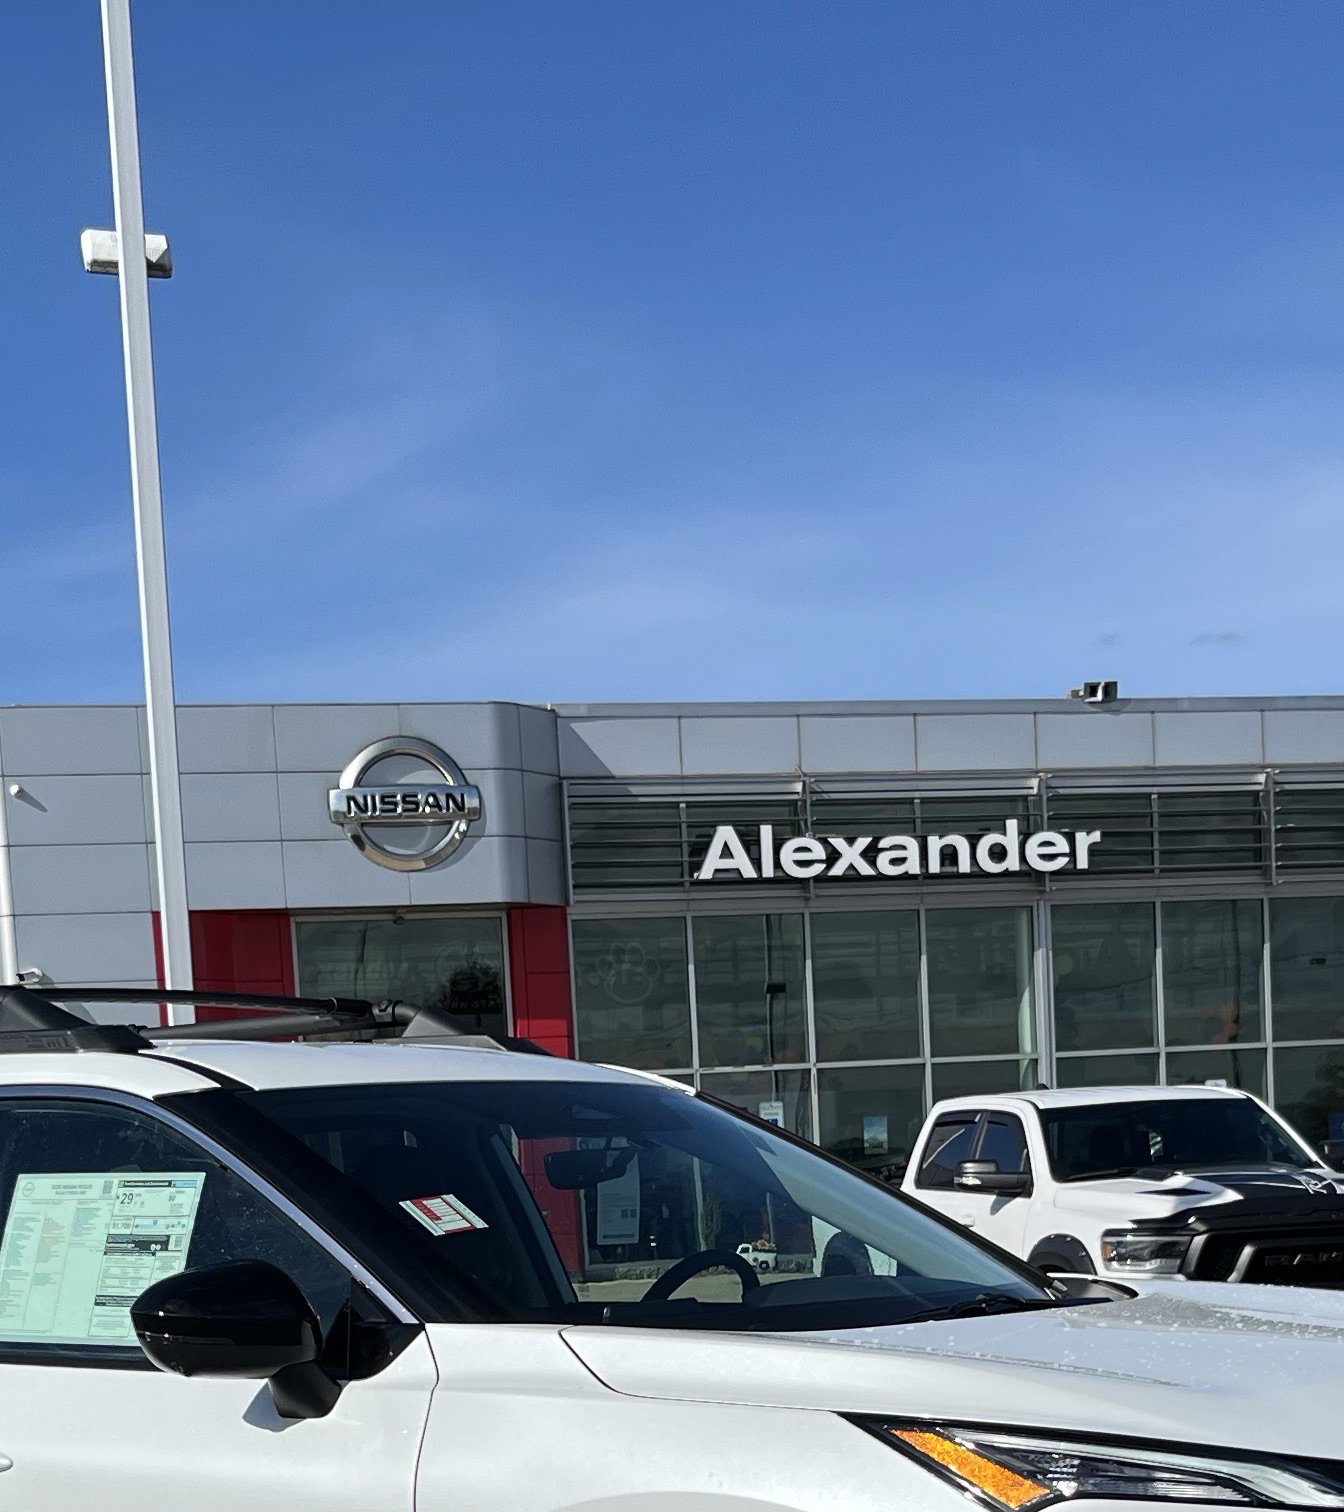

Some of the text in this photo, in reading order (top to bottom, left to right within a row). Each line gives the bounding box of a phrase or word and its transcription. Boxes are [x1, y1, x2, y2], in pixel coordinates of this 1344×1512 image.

[346, 792, 466, 816] NISSAN
[697, 818, 1102, 880] Alexander
[120, 1193, 134, 1205] 29
